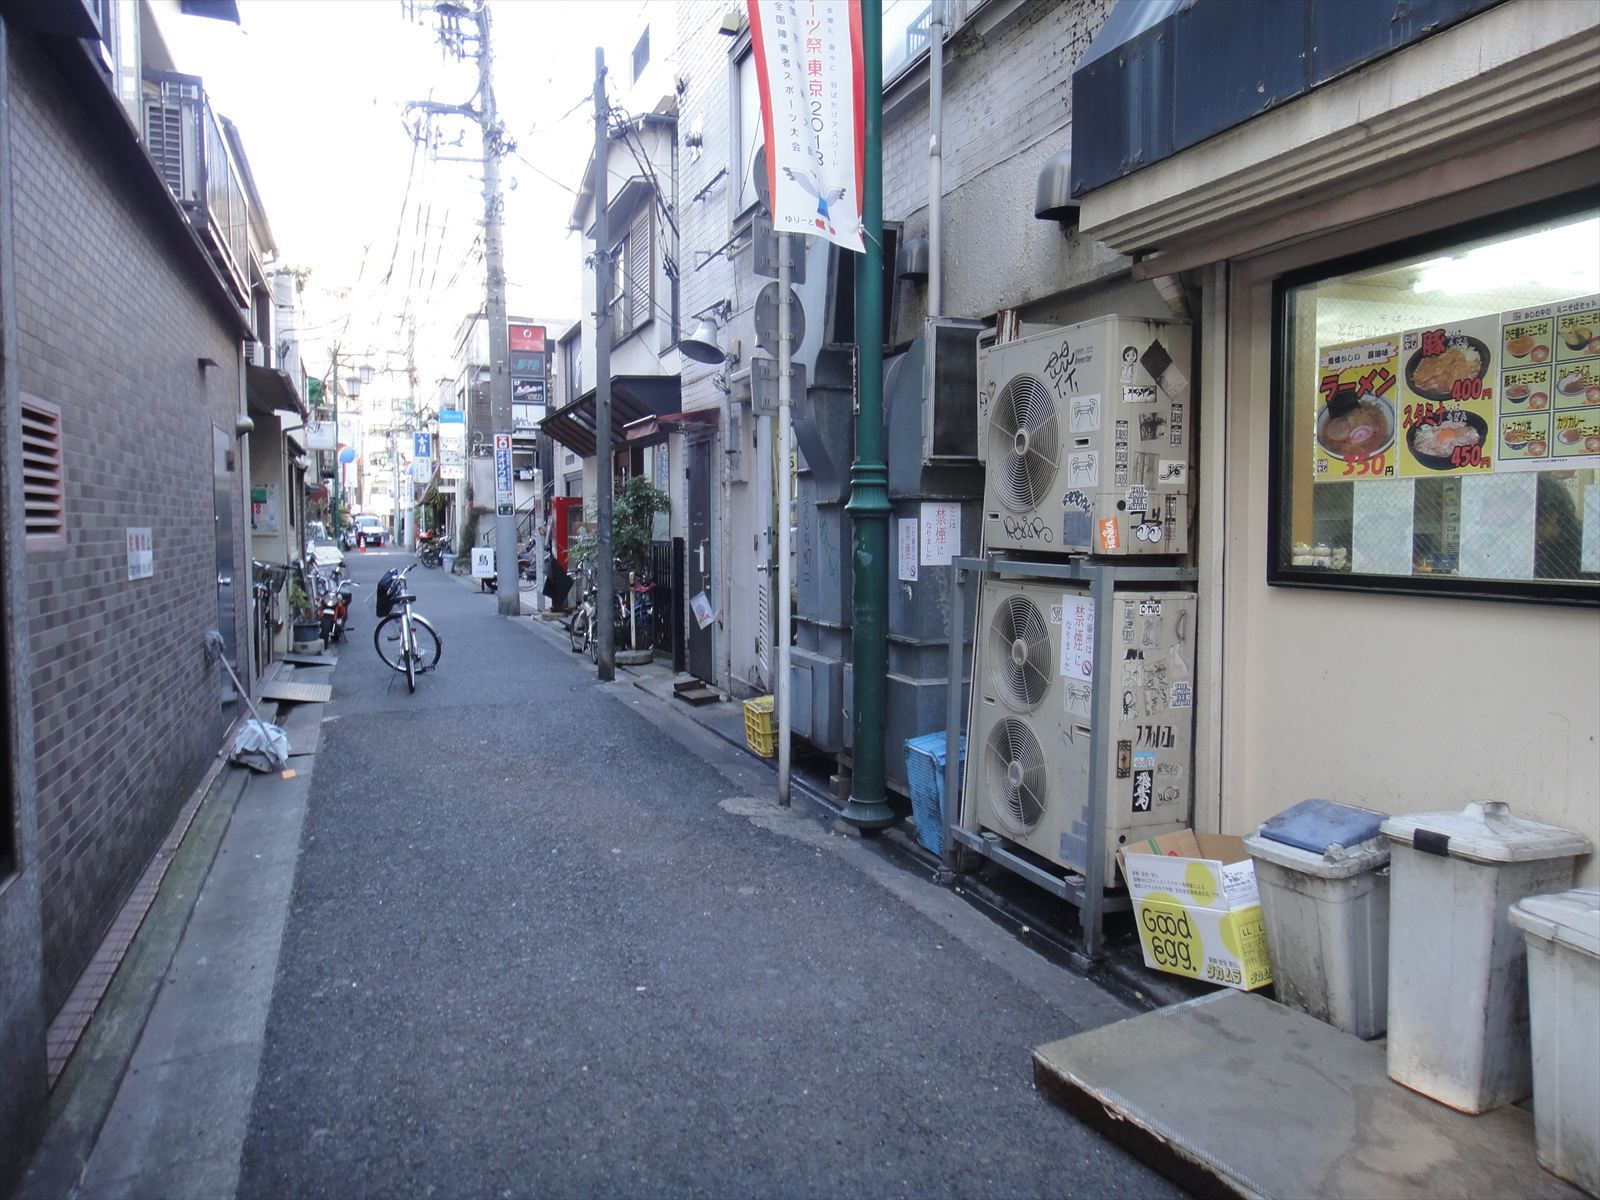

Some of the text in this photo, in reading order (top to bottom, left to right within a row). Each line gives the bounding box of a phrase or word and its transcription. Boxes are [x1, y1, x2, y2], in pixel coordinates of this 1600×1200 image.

[805, 0, 824, 167] ーツ祭東京2013
[785, 215, 814, 226] ゆりーと
[1319, 367, 1397, 402] ラーメン
[1451, 377, 1493, 402] 400円
[1403, 400, 1446, 429] スタミナ
[1450, 444, 1492, 469] 450円
[935, 506, 947, 556] 禁煙に
[1064, 620, 1072, 672] なりました
[1073, 603, 1085, 667] 禁煙に
[1085, 602, 1094, 655] この場所は
[1207, 965, 1242, 985] タカムラ
